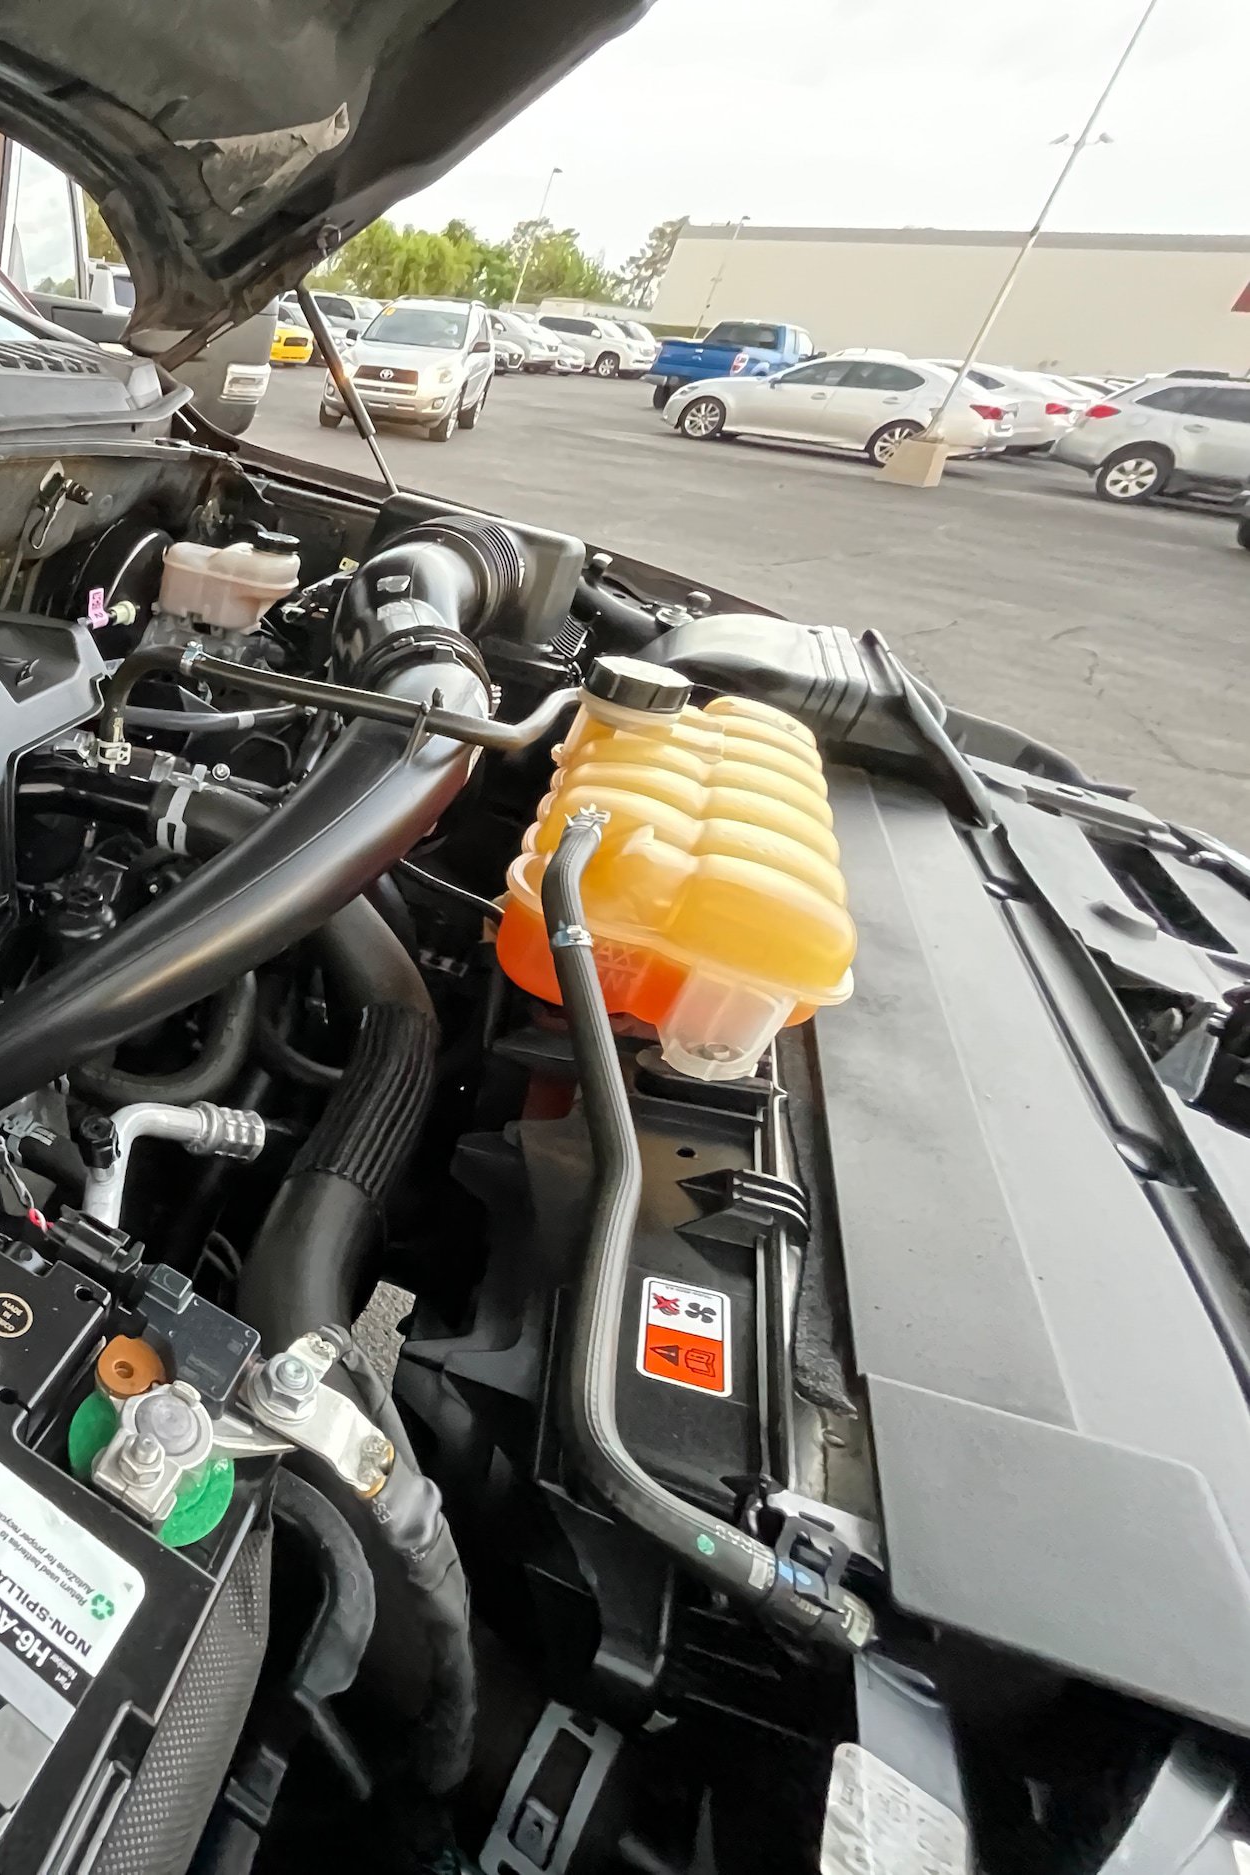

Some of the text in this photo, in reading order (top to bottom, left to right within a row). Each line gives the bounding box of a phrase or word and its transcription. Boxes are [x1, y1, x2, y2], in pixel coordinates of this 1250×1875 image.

[6, 1536, 42, 1568] batteries
[18, 1529, 46, 1555] proper
[41, 1551, 57, 1565] for
[37, 1563, 60, 1585] used
[54, 1561, 95, 1595] AutoZone
[57, 1579, 88, 1607] Return
[48, 1652, 78, 1680] Number
[53, 1671, 72, 1690] Part
